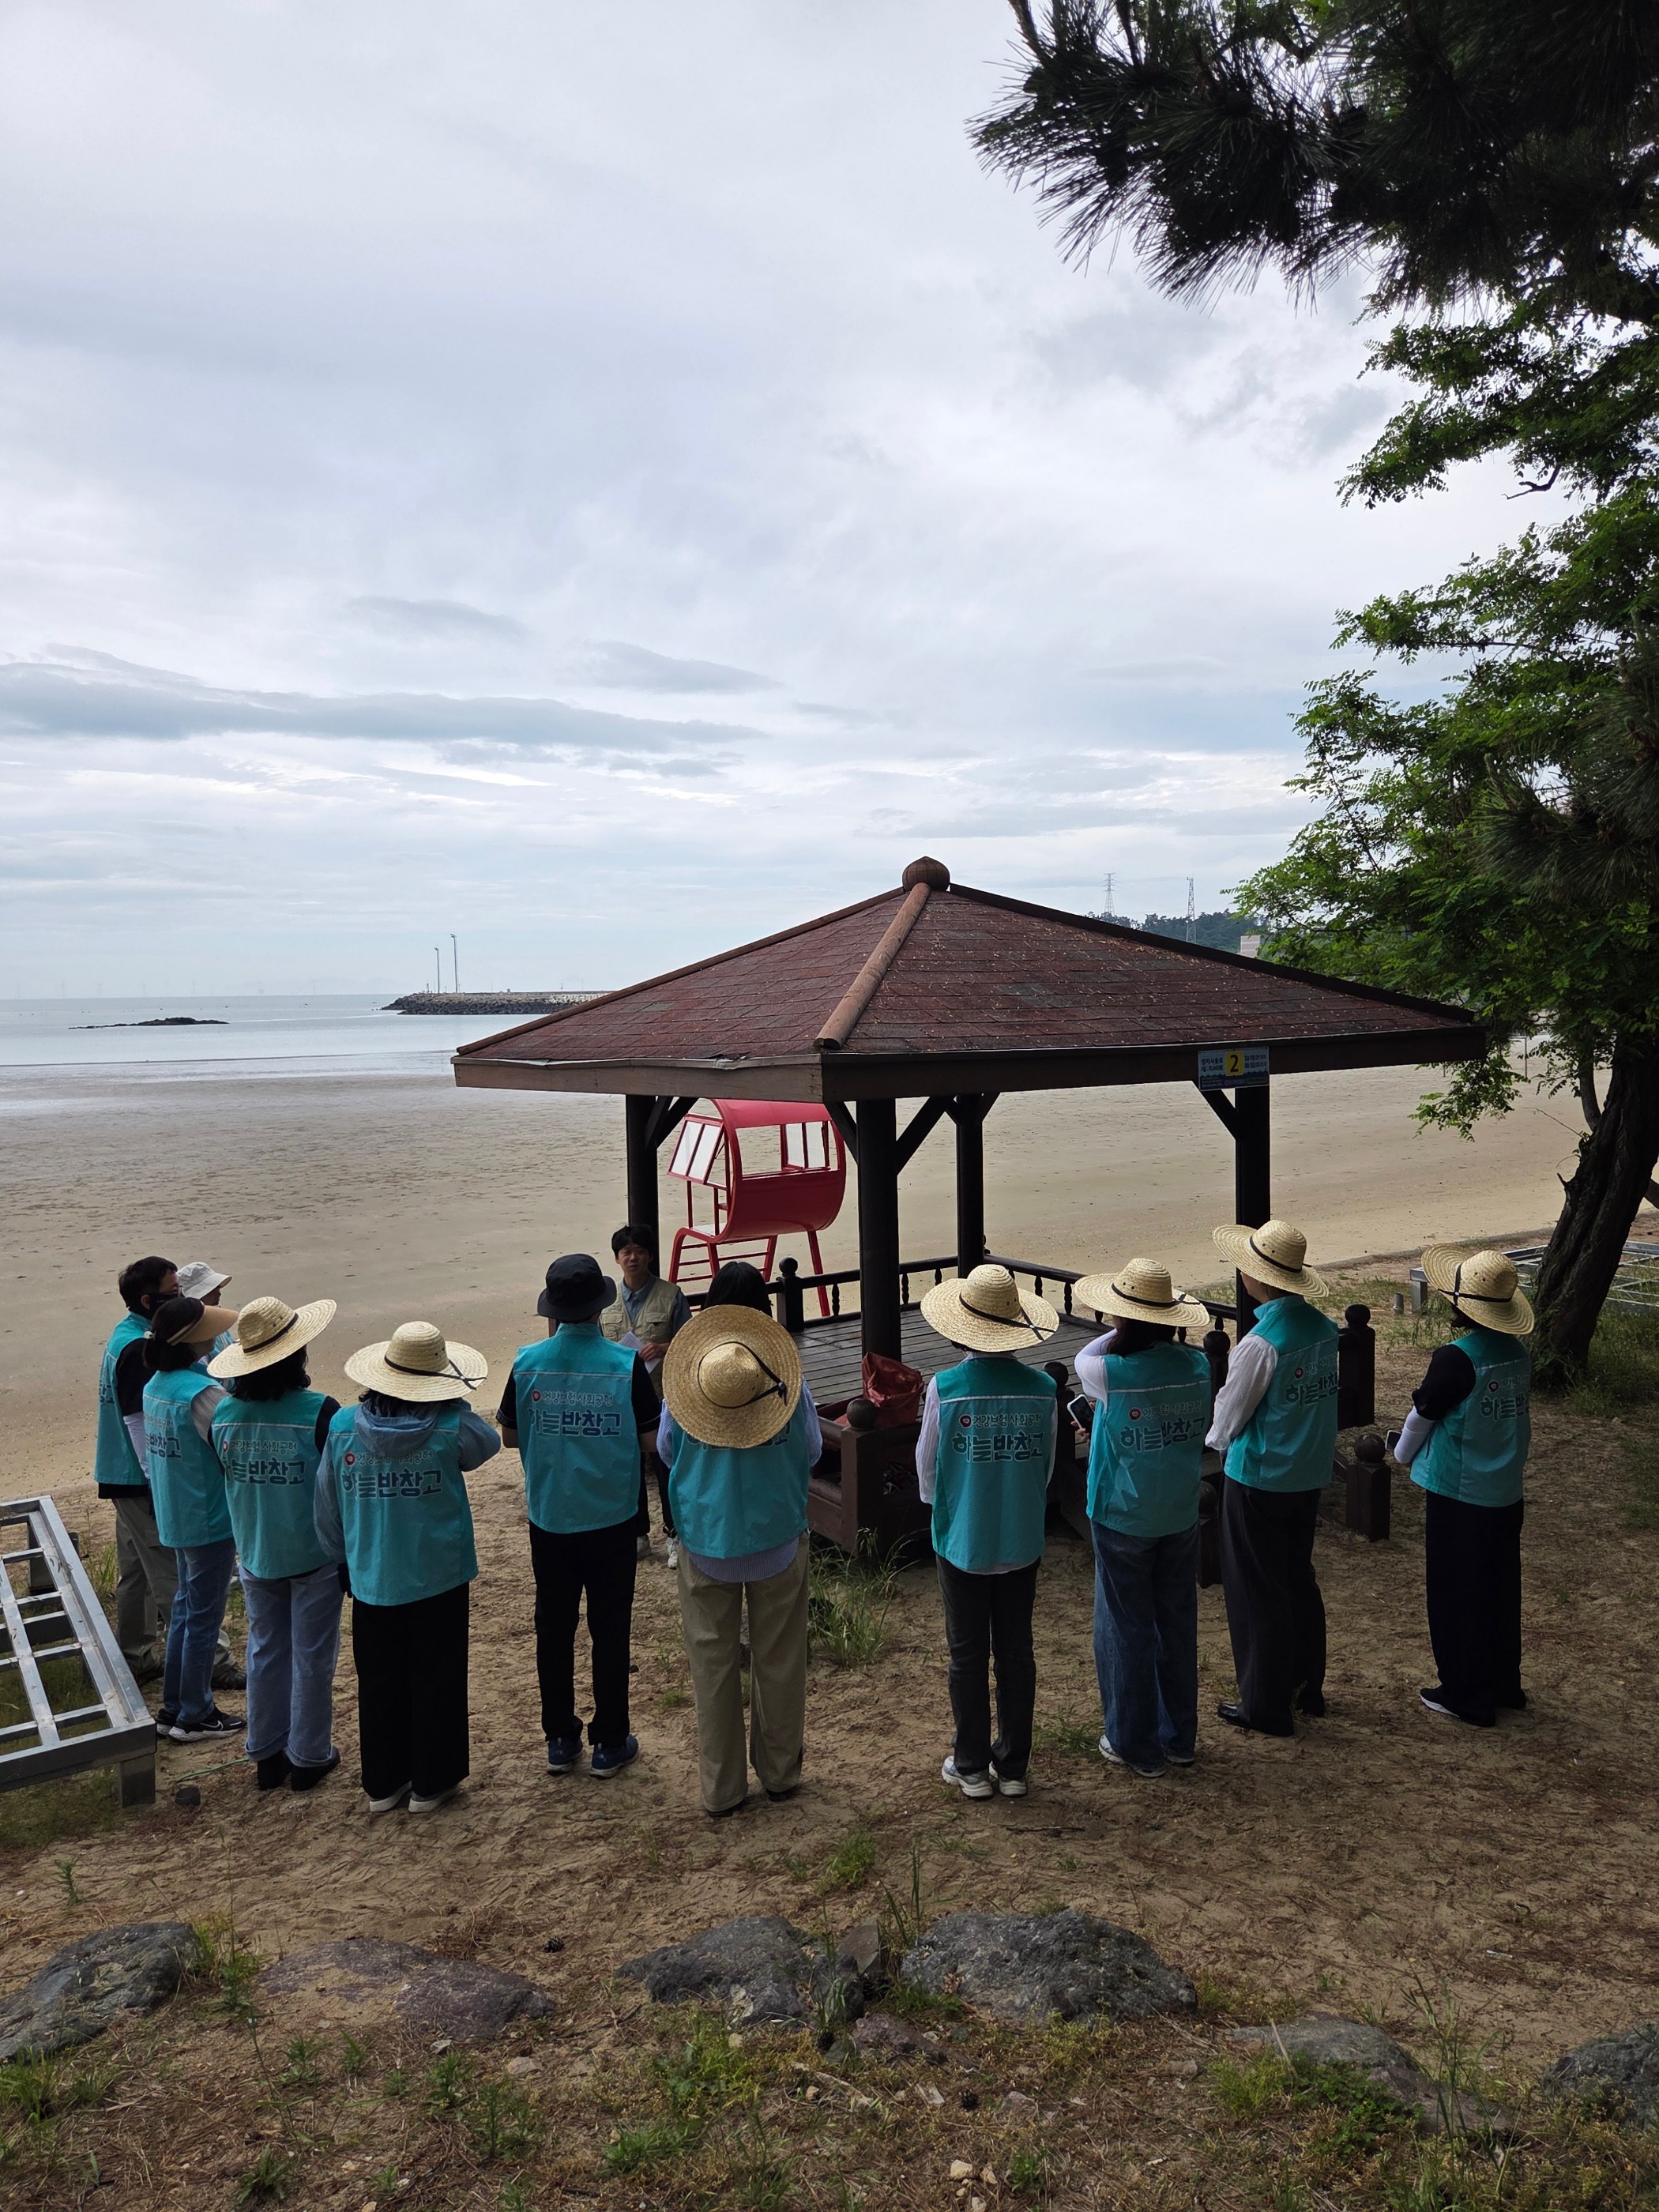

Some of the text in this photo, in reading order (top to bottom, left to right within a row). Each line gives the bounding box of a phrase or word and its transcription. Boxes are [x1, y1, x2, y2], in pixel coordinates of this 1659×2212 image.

[1230, 1054, 1240, 1073] 2
[542, 1390, 613, 1407] 건강보험 사회공헌
[972, 1413, 1043, 1428] 건강보험 사회공헌
[1119, 1417, 1206, 1453] 하늘반창고
[229, 1440, 298, 1454] 건강보험 사회공헌
[952, 1430, 1044, 1463] 하늘반창고
[341, 1467, 442, 1499] 하늘반창고
